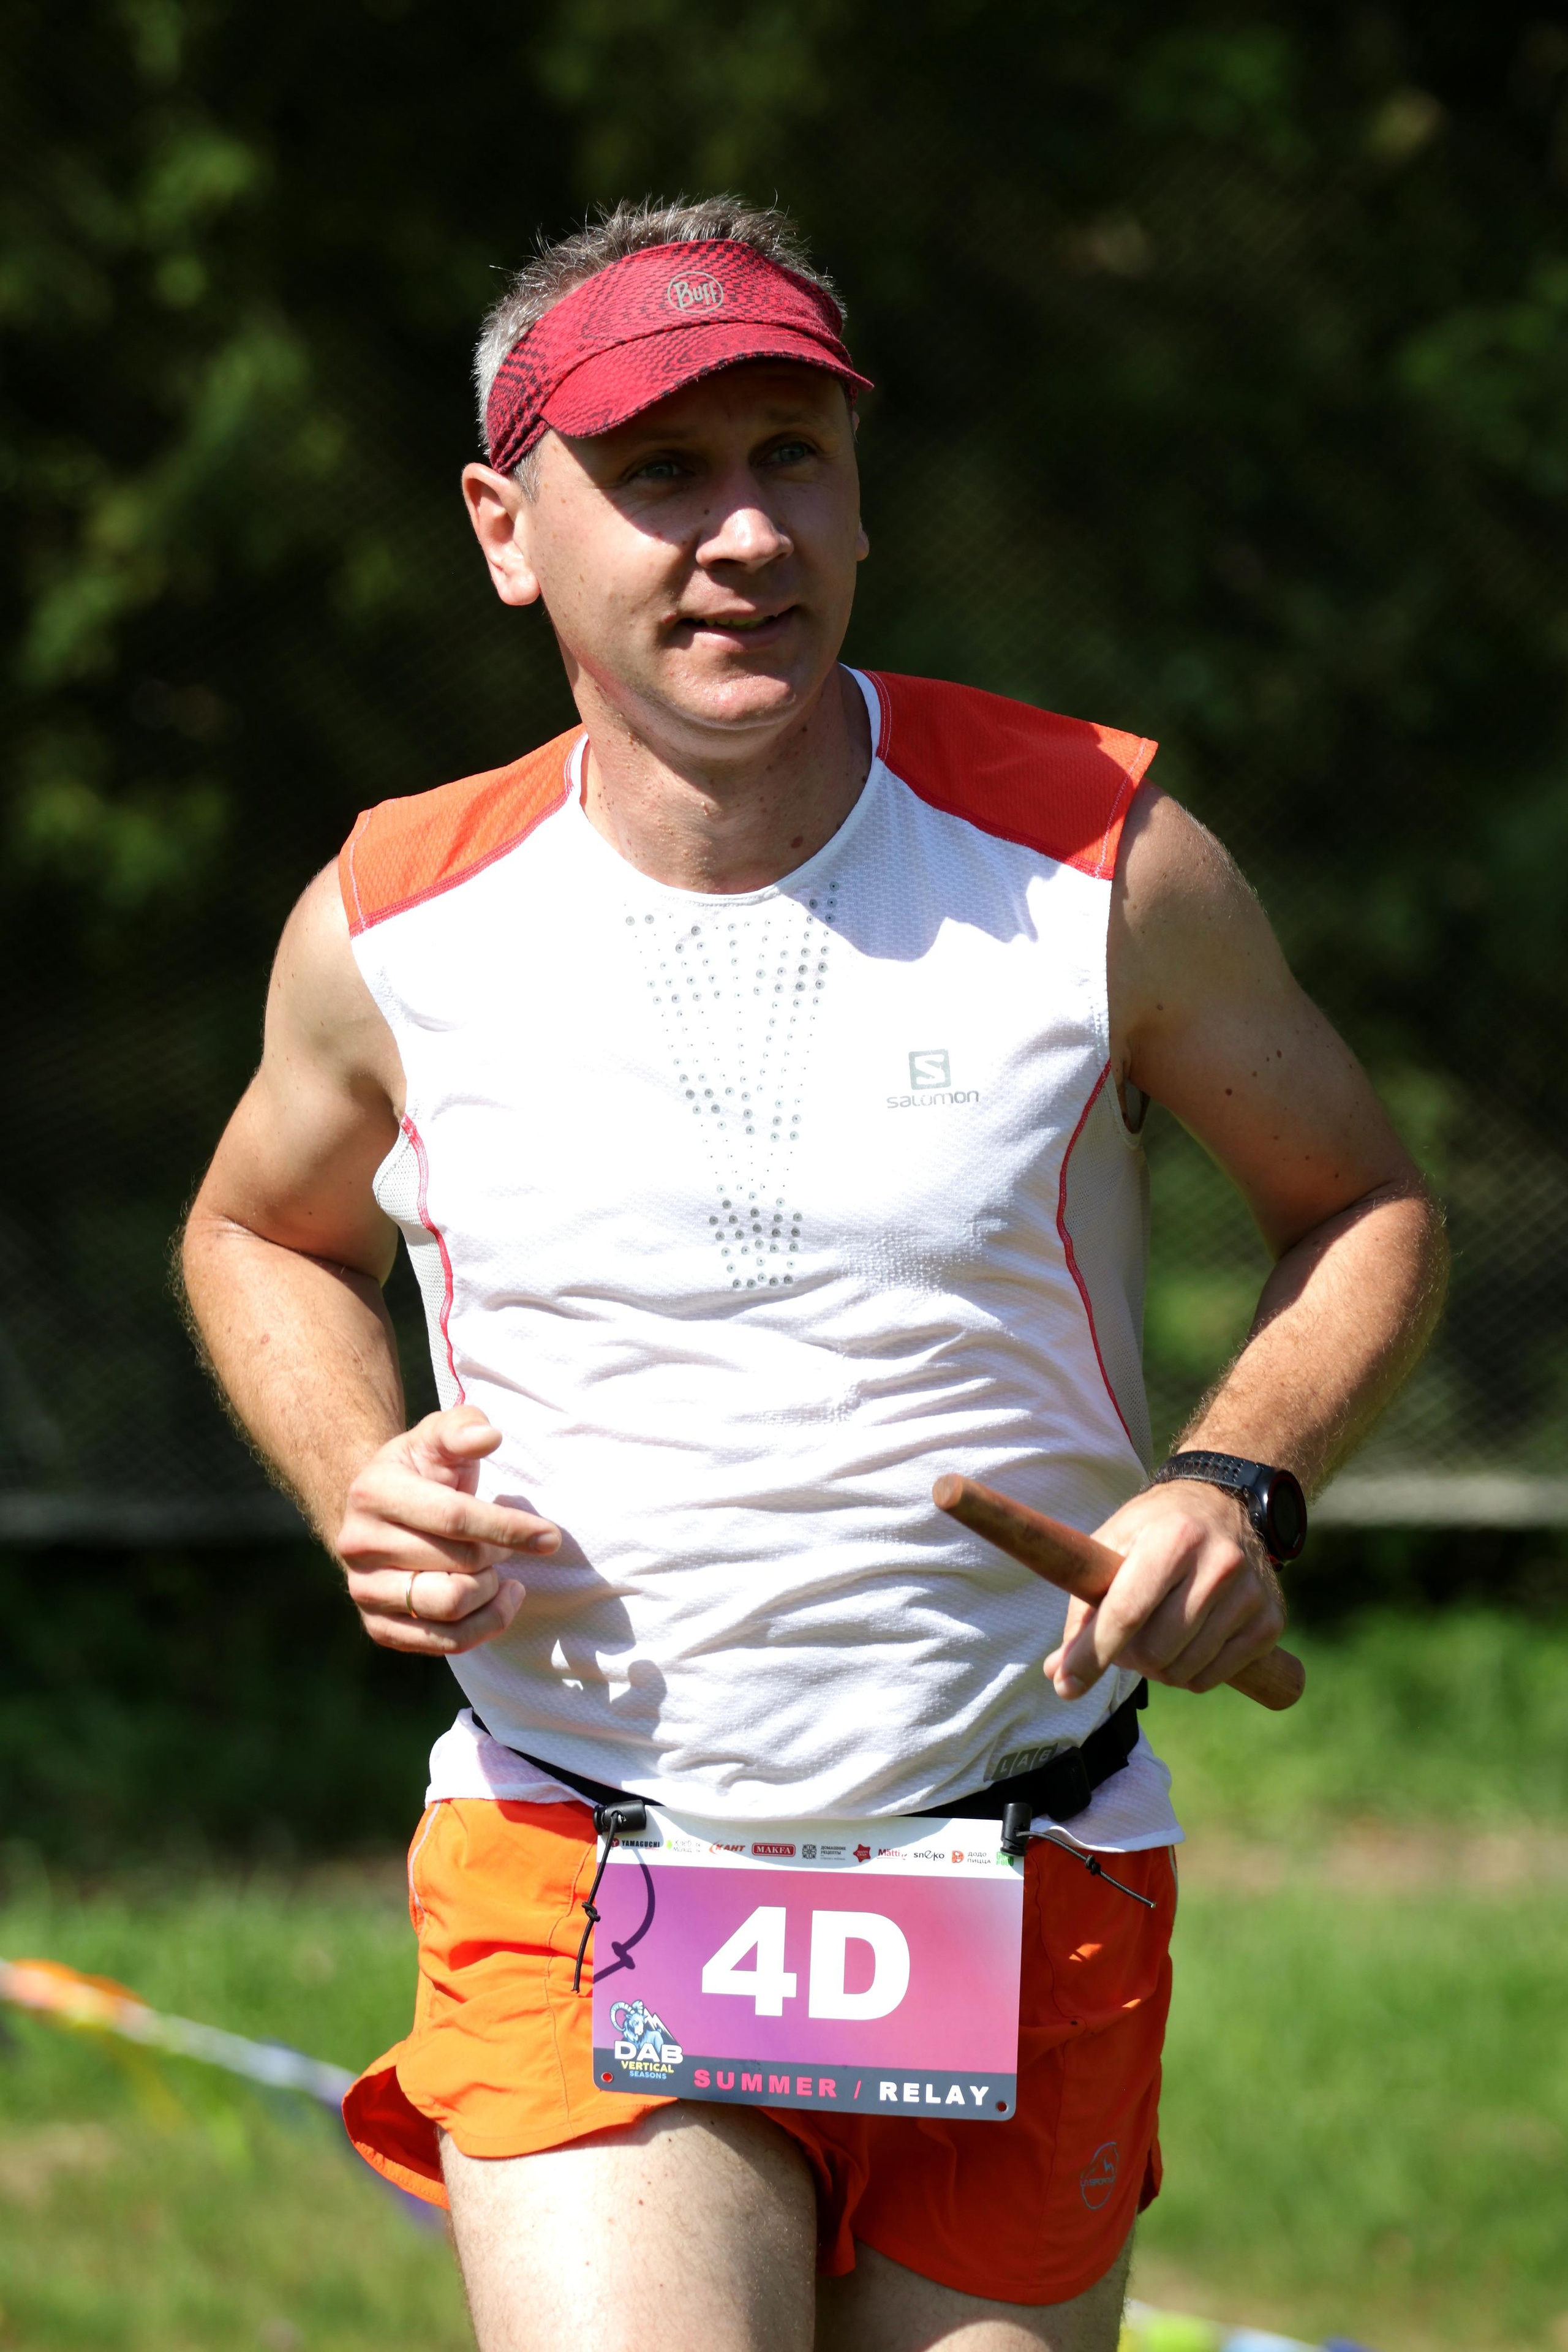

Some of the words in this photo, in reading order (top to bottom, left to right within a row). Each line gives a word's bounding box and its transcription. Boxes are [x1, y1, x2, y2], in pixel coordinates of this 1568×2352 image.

[674, 281, 716, 307] Buff
[886, 1090, 979, 1109] salomon
[756, 1845, 791, 1854] MAKFA
[914, 1850, 944, 1861] sneko
[702, 1906, 910, 2020] 4D
[615, 2041, 683, 2064] DAB
[621, 2060, 674, 2073] VERTICAL
[629, 2070, 667, 2079] SEASONS
[693, 2069, 837, 2098] SUMMER
[879, 2081, 989, 2106] RELAY
